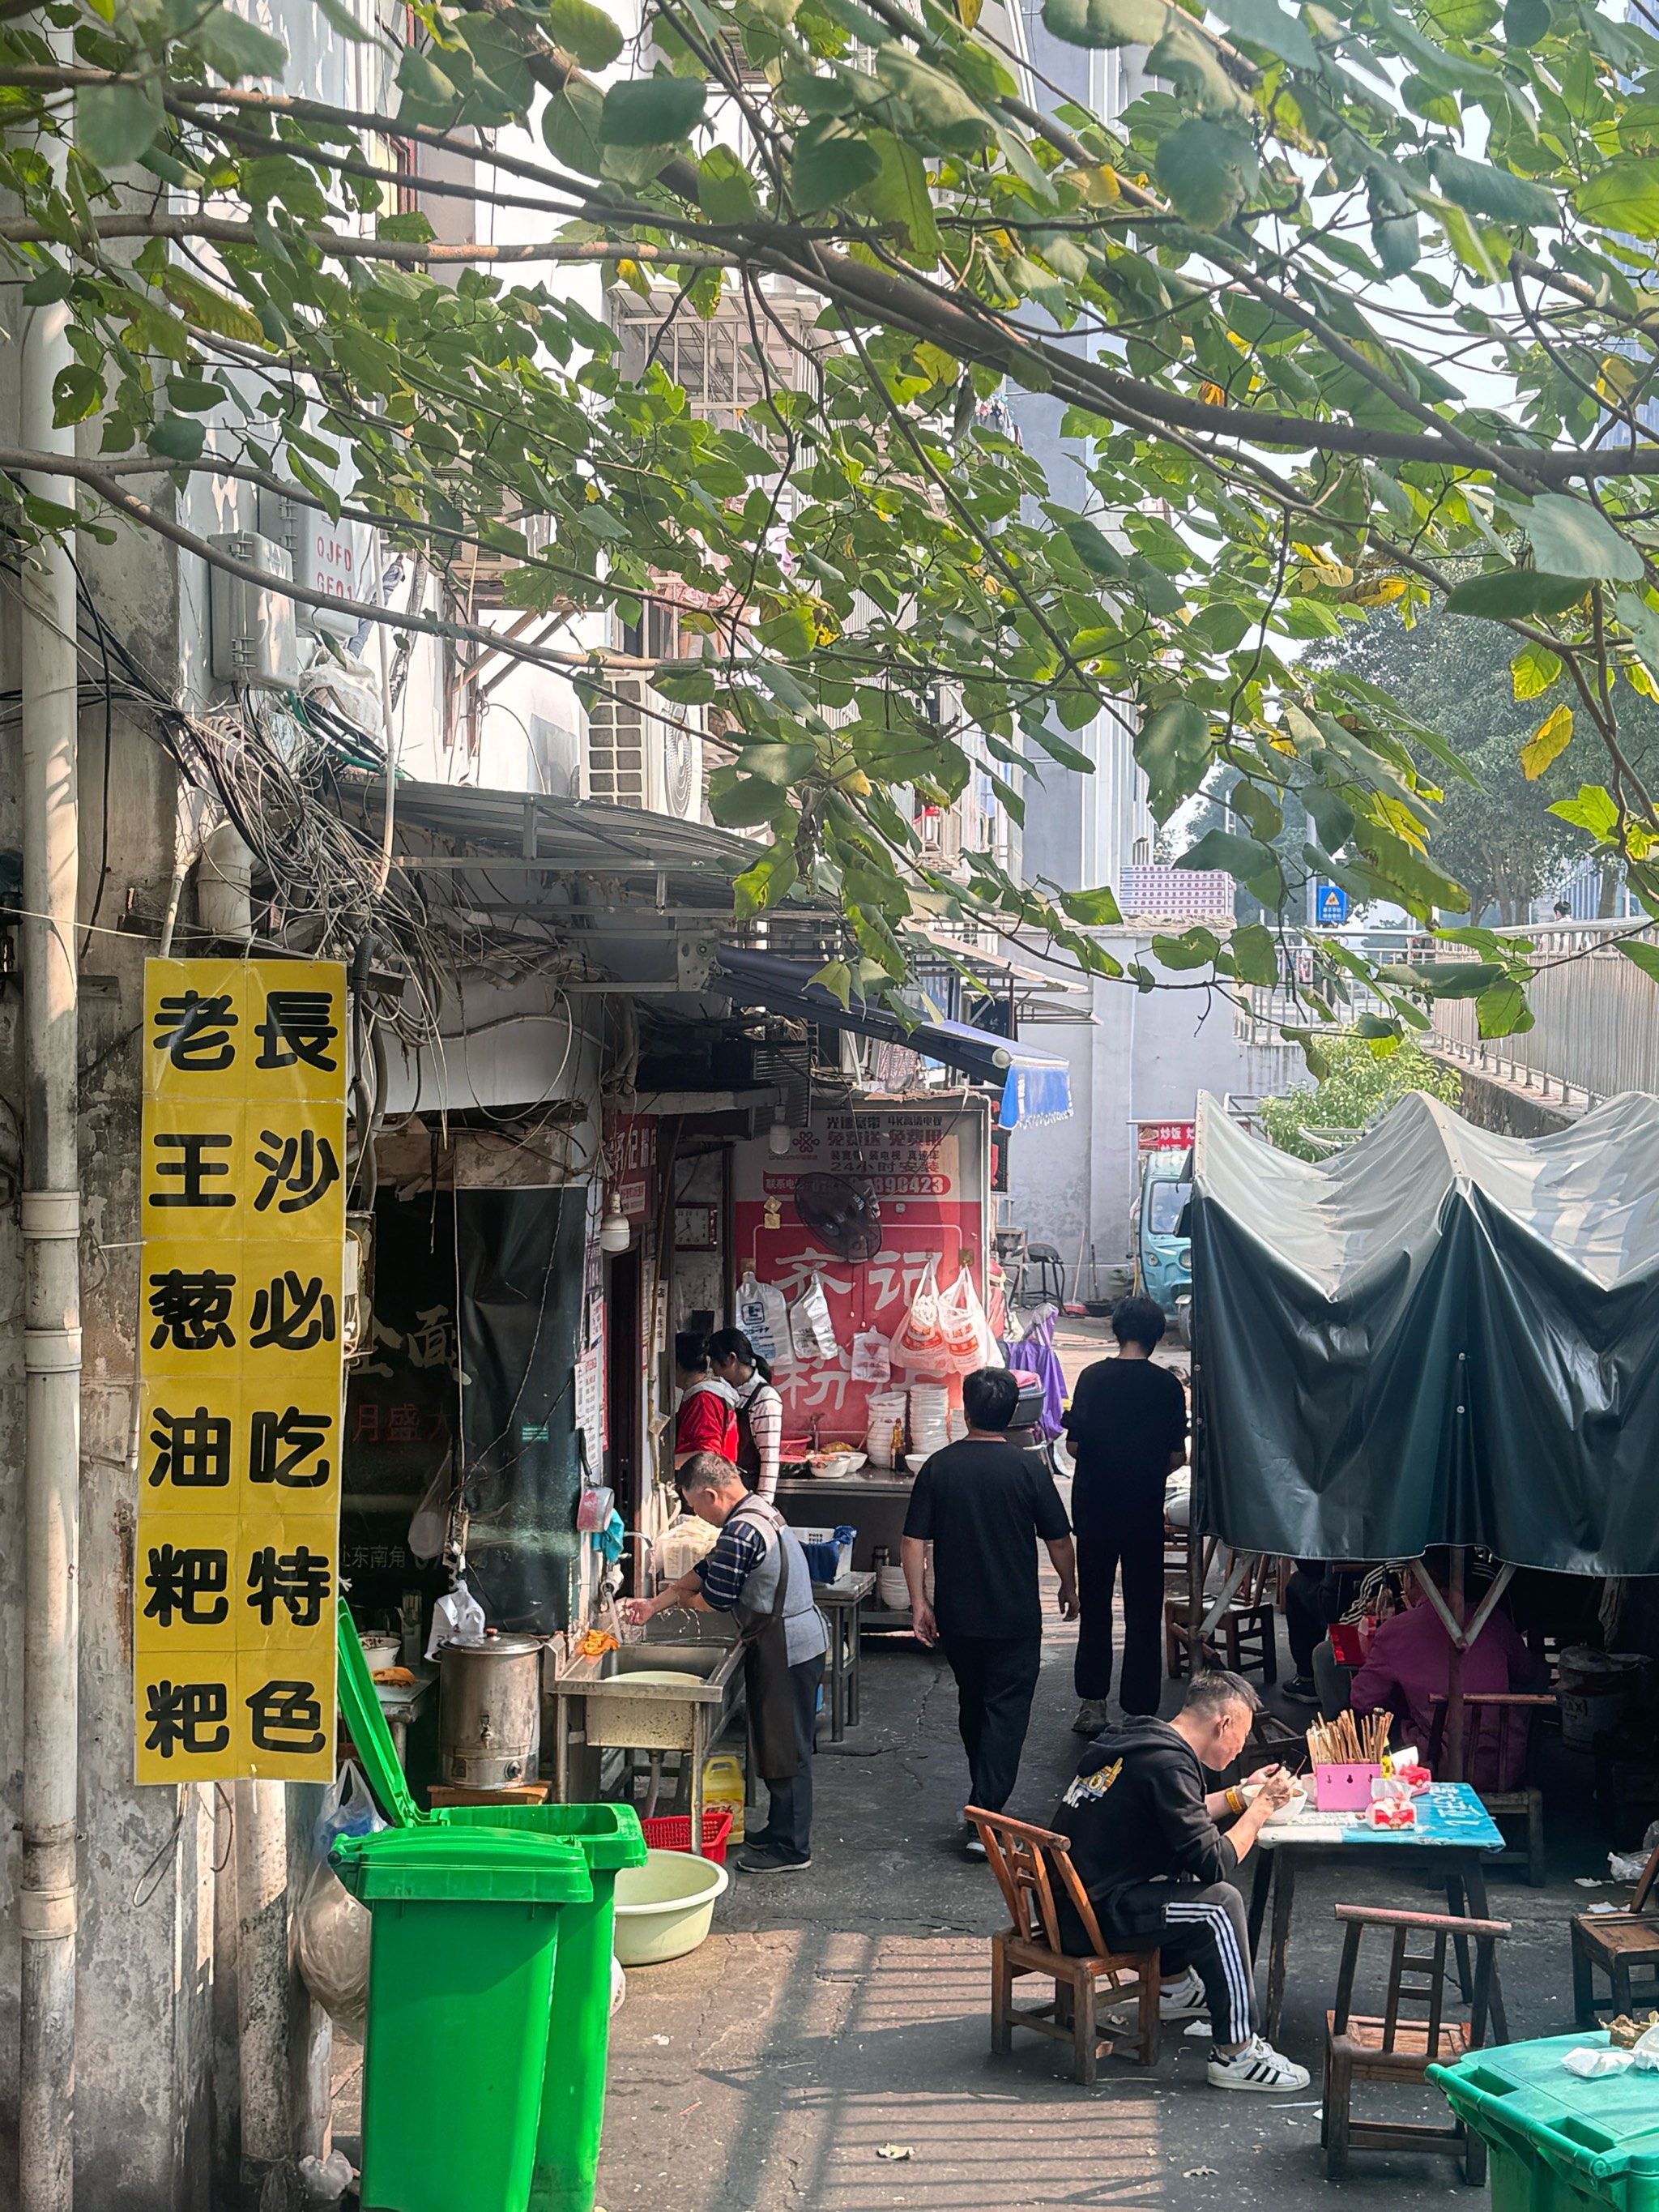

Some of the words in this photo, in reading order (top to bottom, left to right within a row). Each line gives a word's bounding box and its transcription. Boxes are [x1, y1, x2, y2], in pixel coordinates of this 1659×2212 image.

[145, 989, 238, 1759] 老王葱油粑粑
[245, 991, 339, 1756] 長沙必吃特色
[830, 1161, 940, 1172] 24小时安装
